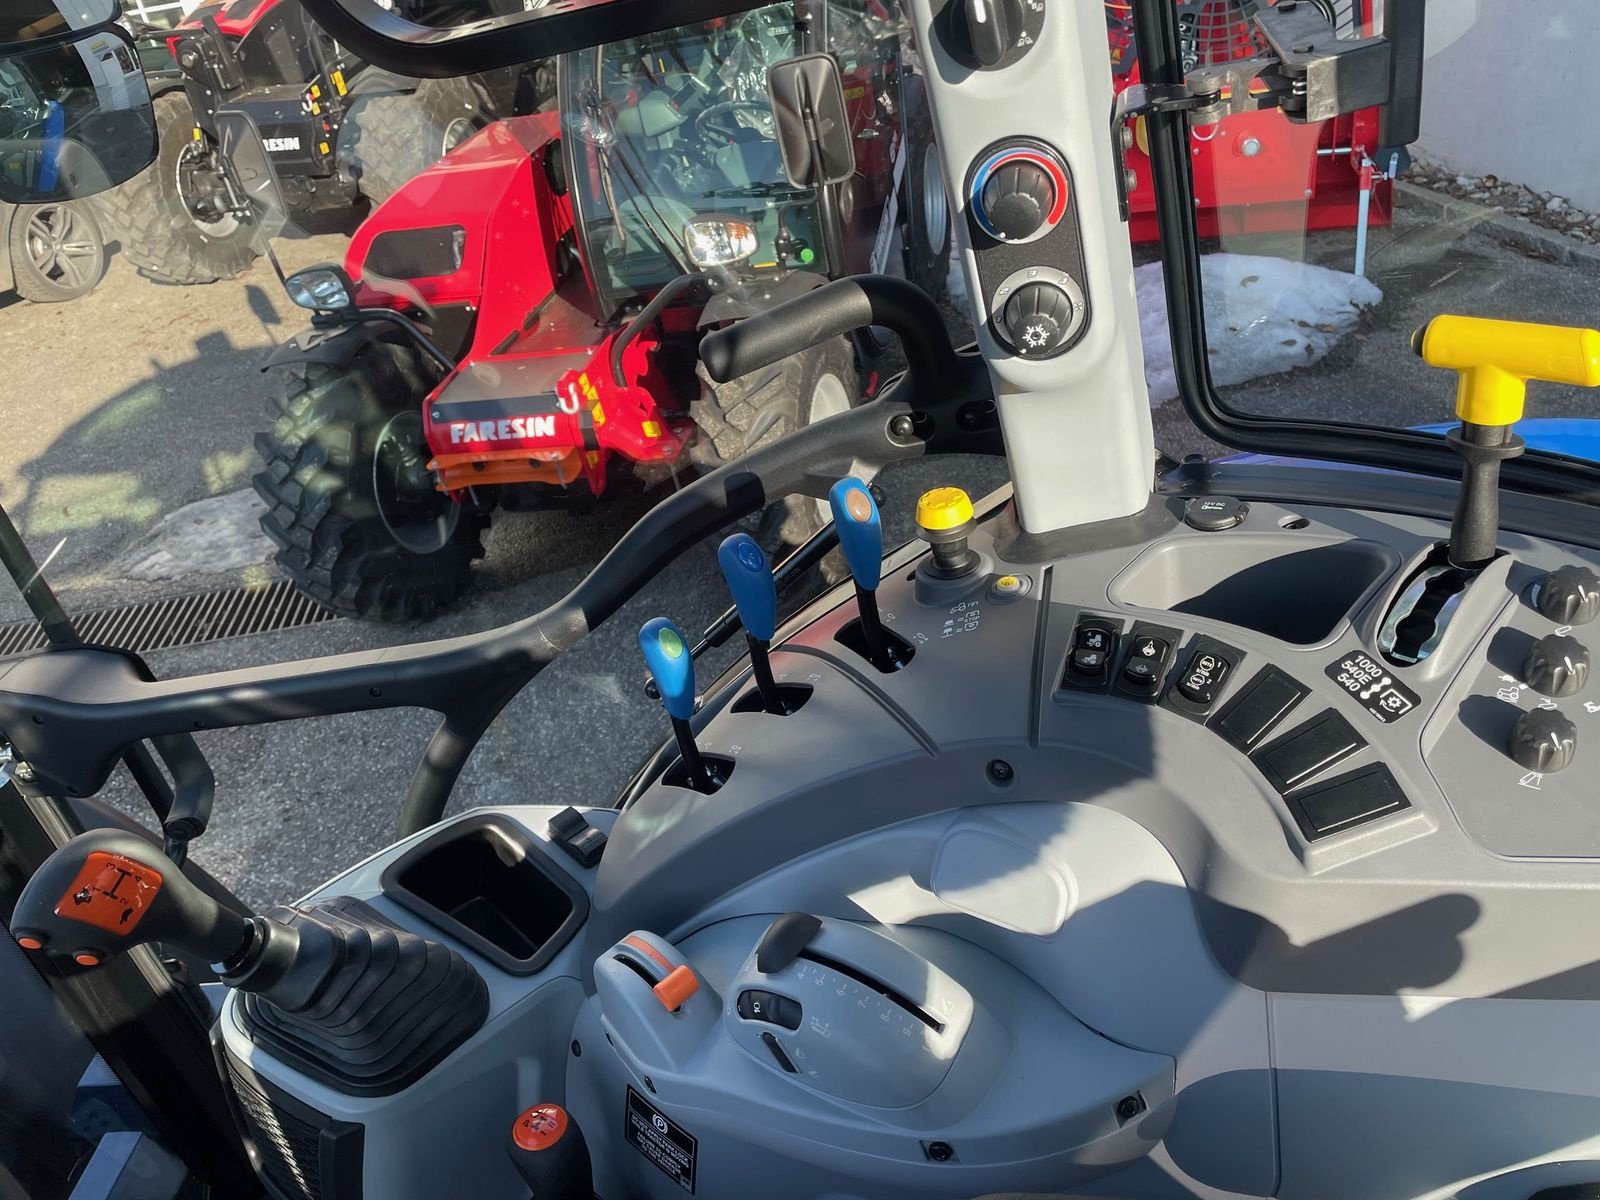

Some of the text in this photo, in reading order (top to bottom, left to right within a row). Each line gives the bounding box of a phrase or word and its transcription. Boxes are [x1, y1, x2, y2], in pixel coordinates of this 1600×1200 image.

[450, 415, 555, 444] FARESIN
[1341, 660, 1373, 685] 540E
[1354, 655, 1383, 678] 1000
[1337, 672, 1361, 692] 540
[106, 862, 116, 870] 3
[657, 1118, 664, 1128] P
